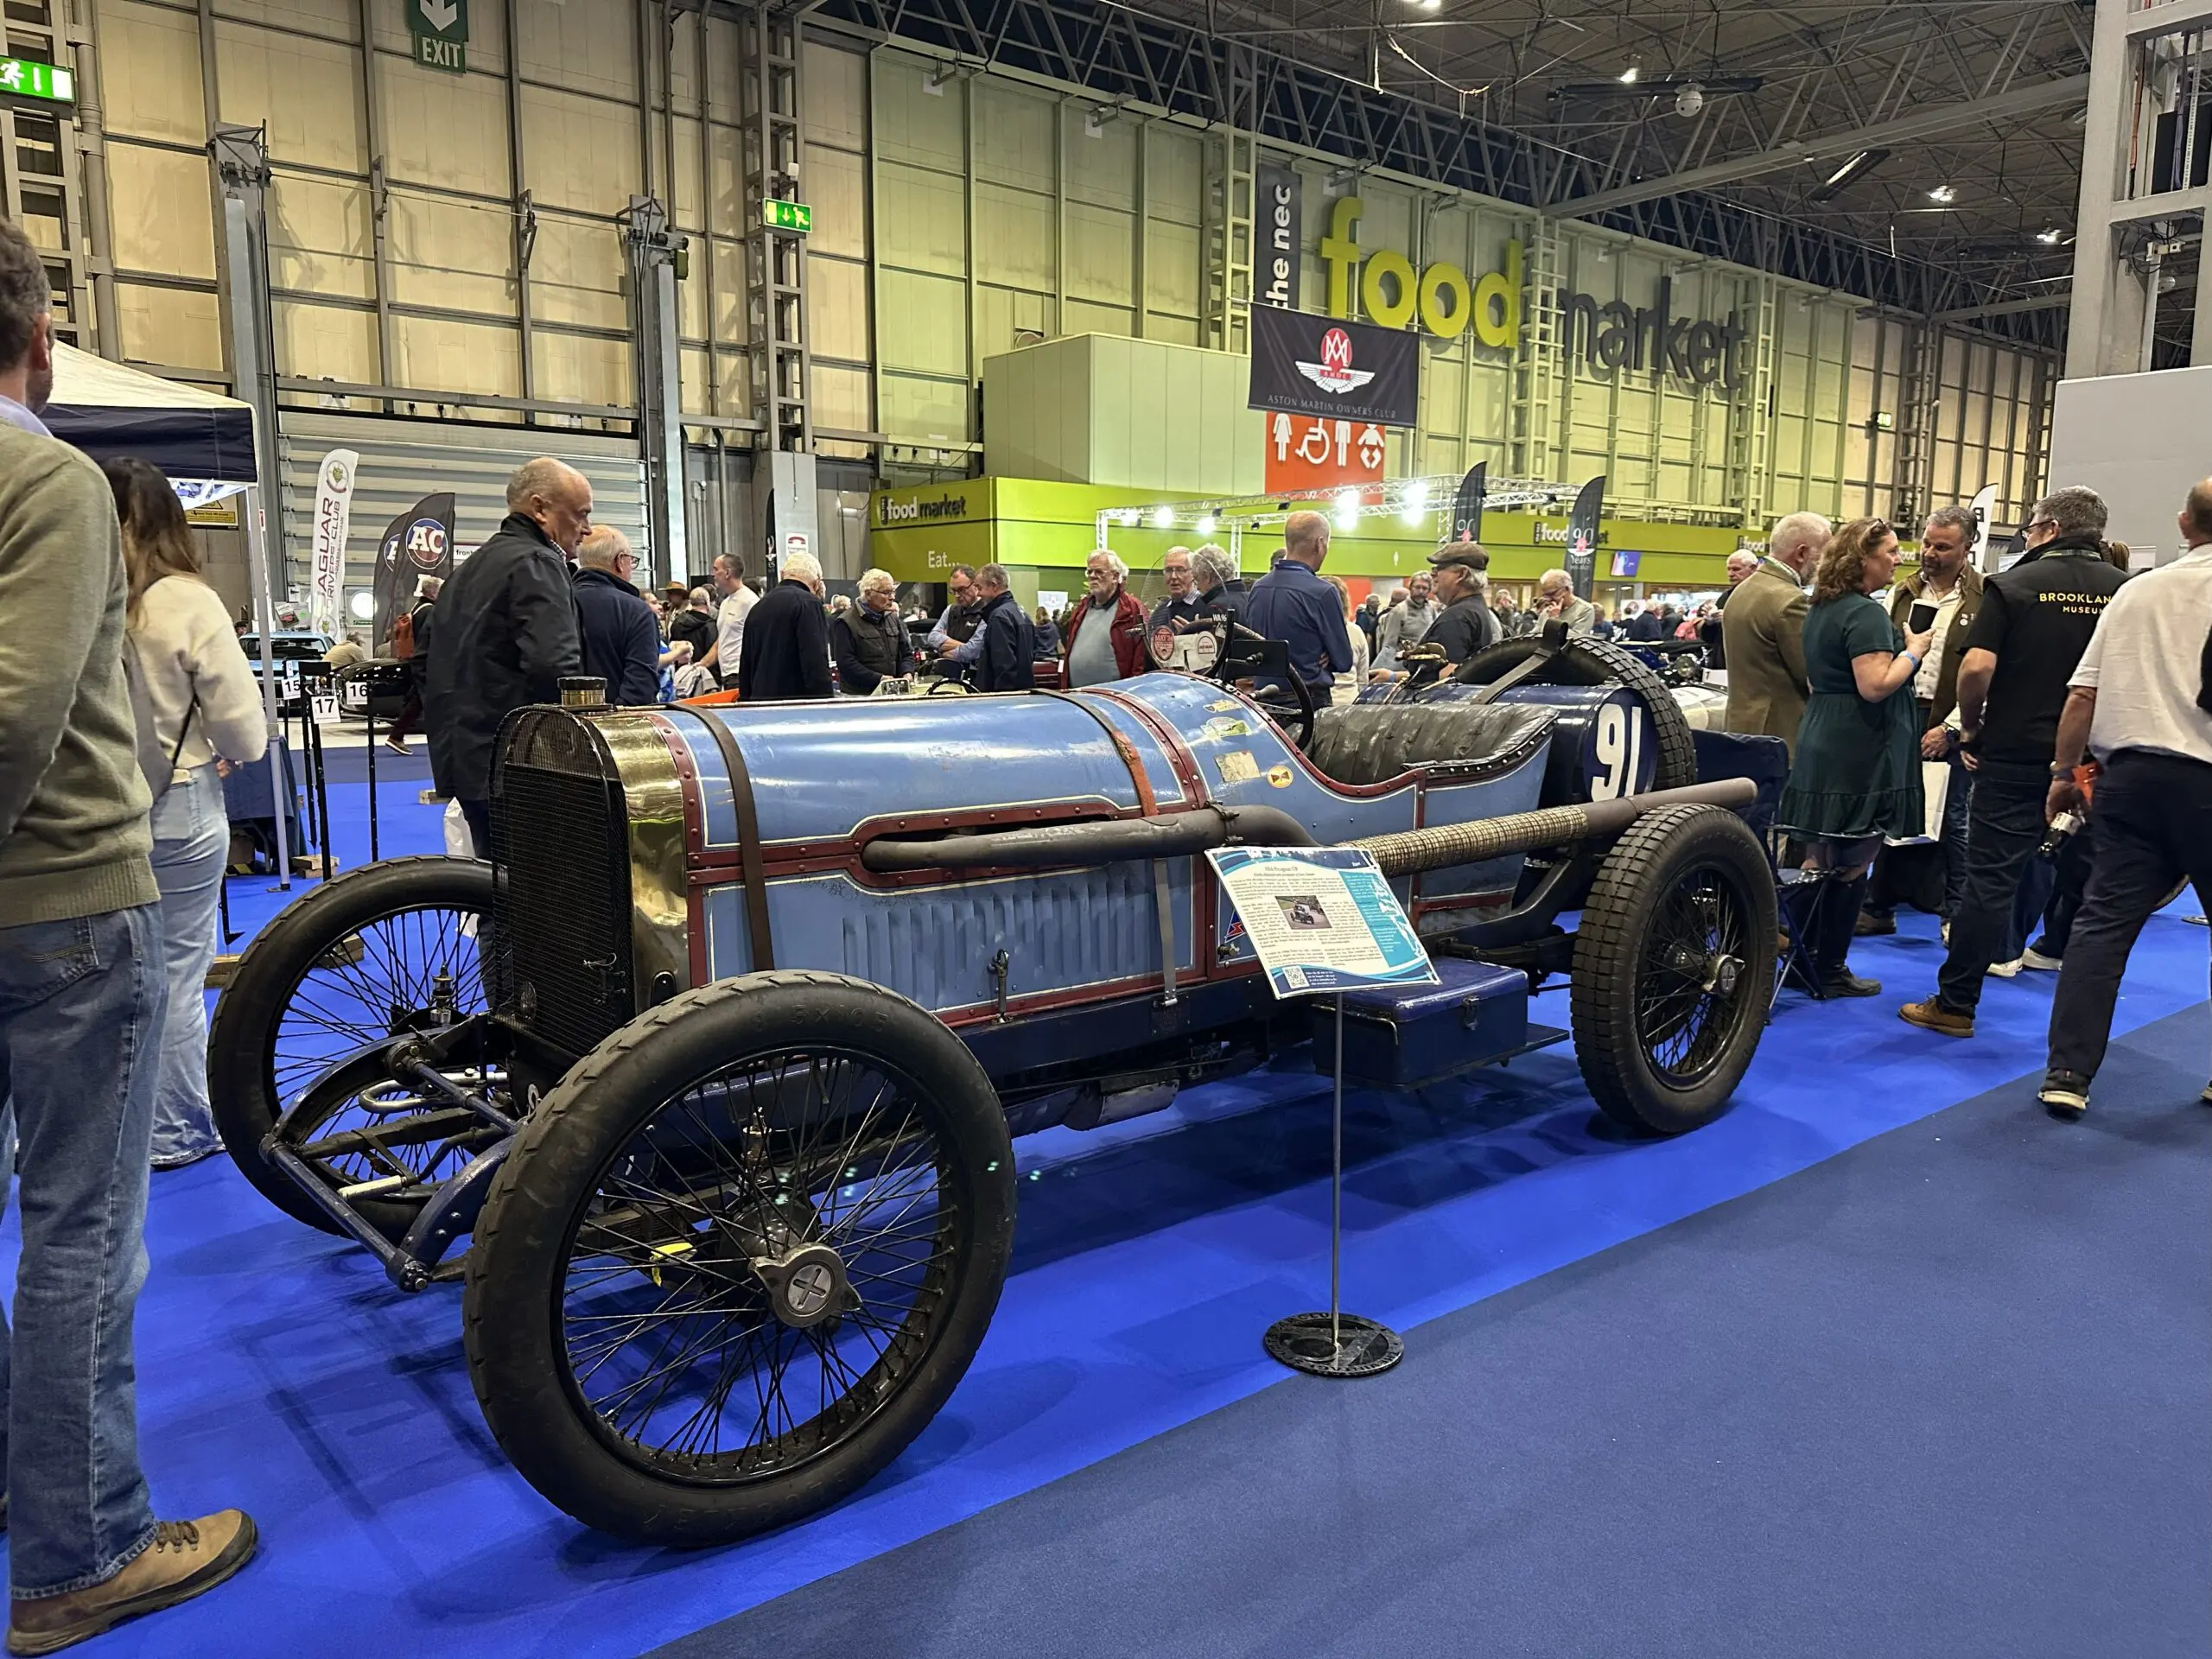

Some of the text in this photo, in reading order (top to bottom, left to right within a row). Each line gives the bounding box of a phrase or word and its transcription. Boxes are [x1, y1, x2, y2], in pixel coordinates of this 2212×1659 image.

[422, 36, 461, 68] EXIT
[1274, 184, 1291, 251] nec
[1321, 196, 1523, 349] food
[1268, 394, 1396, 420] ASTON MARTIN OWNERS CLUB
[330, 500, 340, 540] CLUB
[887, 495, 918, 520] food
[918, 493, 967, 518] market
[408, 525, 445, 555] AC
[284, 678, 301, 693] 15
[349, 683, 367, 697] 16
[315, 697, 334, 714] 17
[1591, 702, 1642, 803] 91
